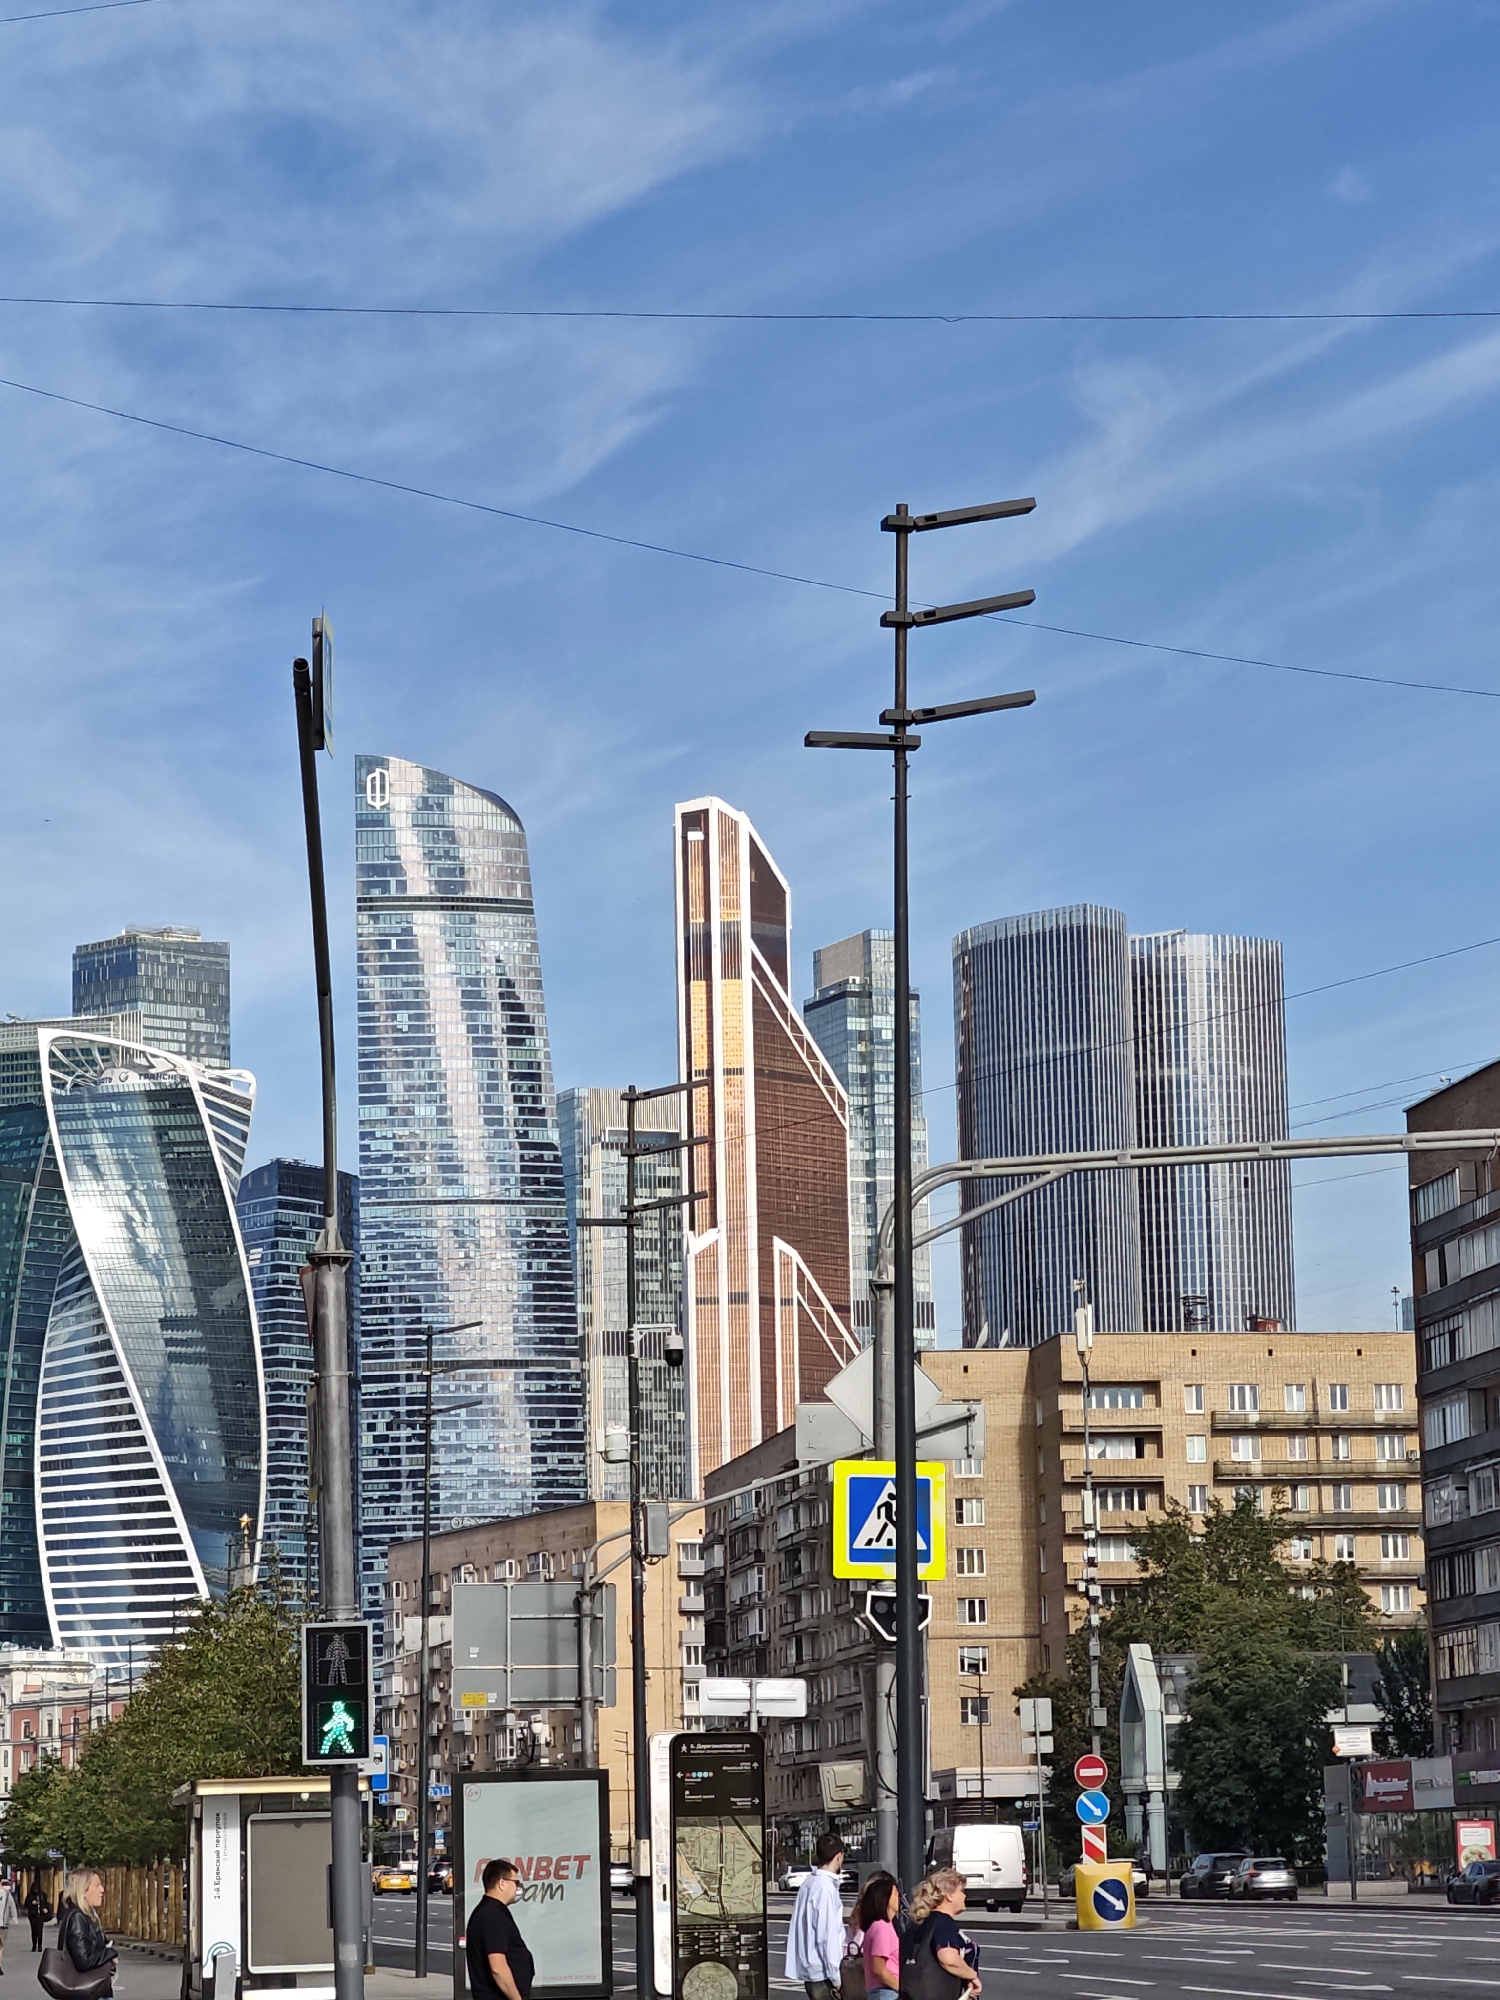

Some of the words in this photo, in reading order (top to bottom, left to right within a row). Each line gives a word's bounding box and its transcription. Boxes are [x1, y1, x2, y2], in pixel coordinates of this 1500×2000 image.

[138, 1072, 189, 1082] ТРАНСНЕФ
[215, 1811, 223, 1848] переулок
[213, 1849, 222, 1886] Брянский
[473, 1854, 592, 1883] FNBET
[213, 1887, 221, 1900] 2-й
